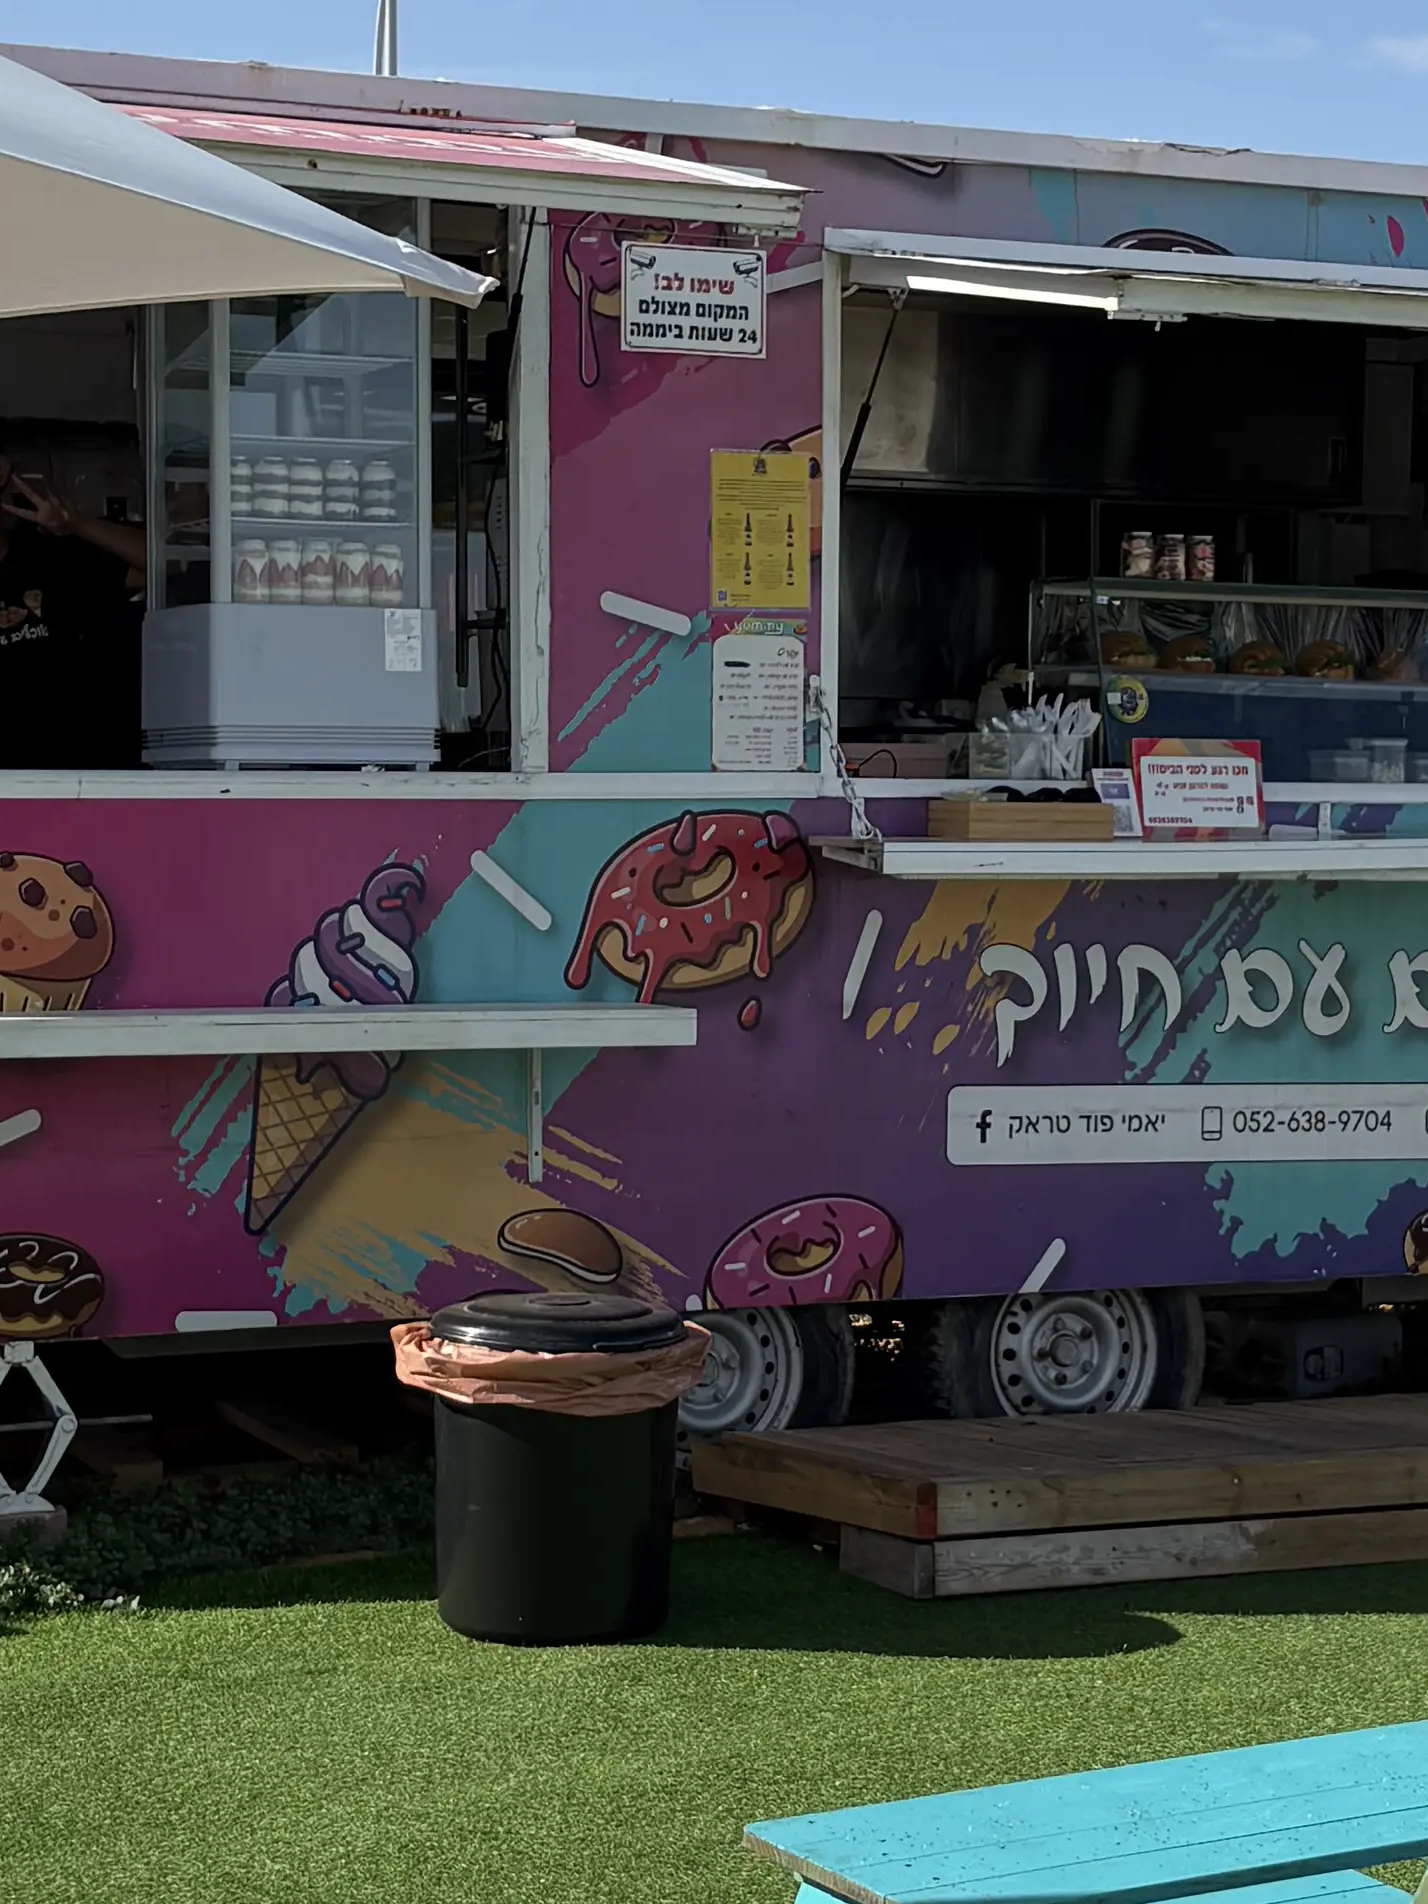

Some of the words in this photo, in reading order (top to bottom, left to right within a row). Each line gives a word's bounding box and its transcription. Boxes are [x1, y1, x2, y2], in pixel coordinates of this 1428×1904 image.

[654, 272, 685, 292] לב!
[690, 277, 735, 295] שימו
[638, 296, 691, 317] מצולם
[695, 302, 749, 323] המקום
[630, 322, 683, 339] ביממה
[688, 324, 733, 342] שעות
[738, 328, 758, 344] 24
[1214, 939, 1353, 1038] עם
[979, 941, 1183, 1069] חיוך
[1008, 1114, 1071, 1139] טראק
[1078, 1114, 1114, 1133] פוד
[1121, 1114, 1166, 1133] יאמי
[1232, 1110, 1392, 1133] 052-638-9704
